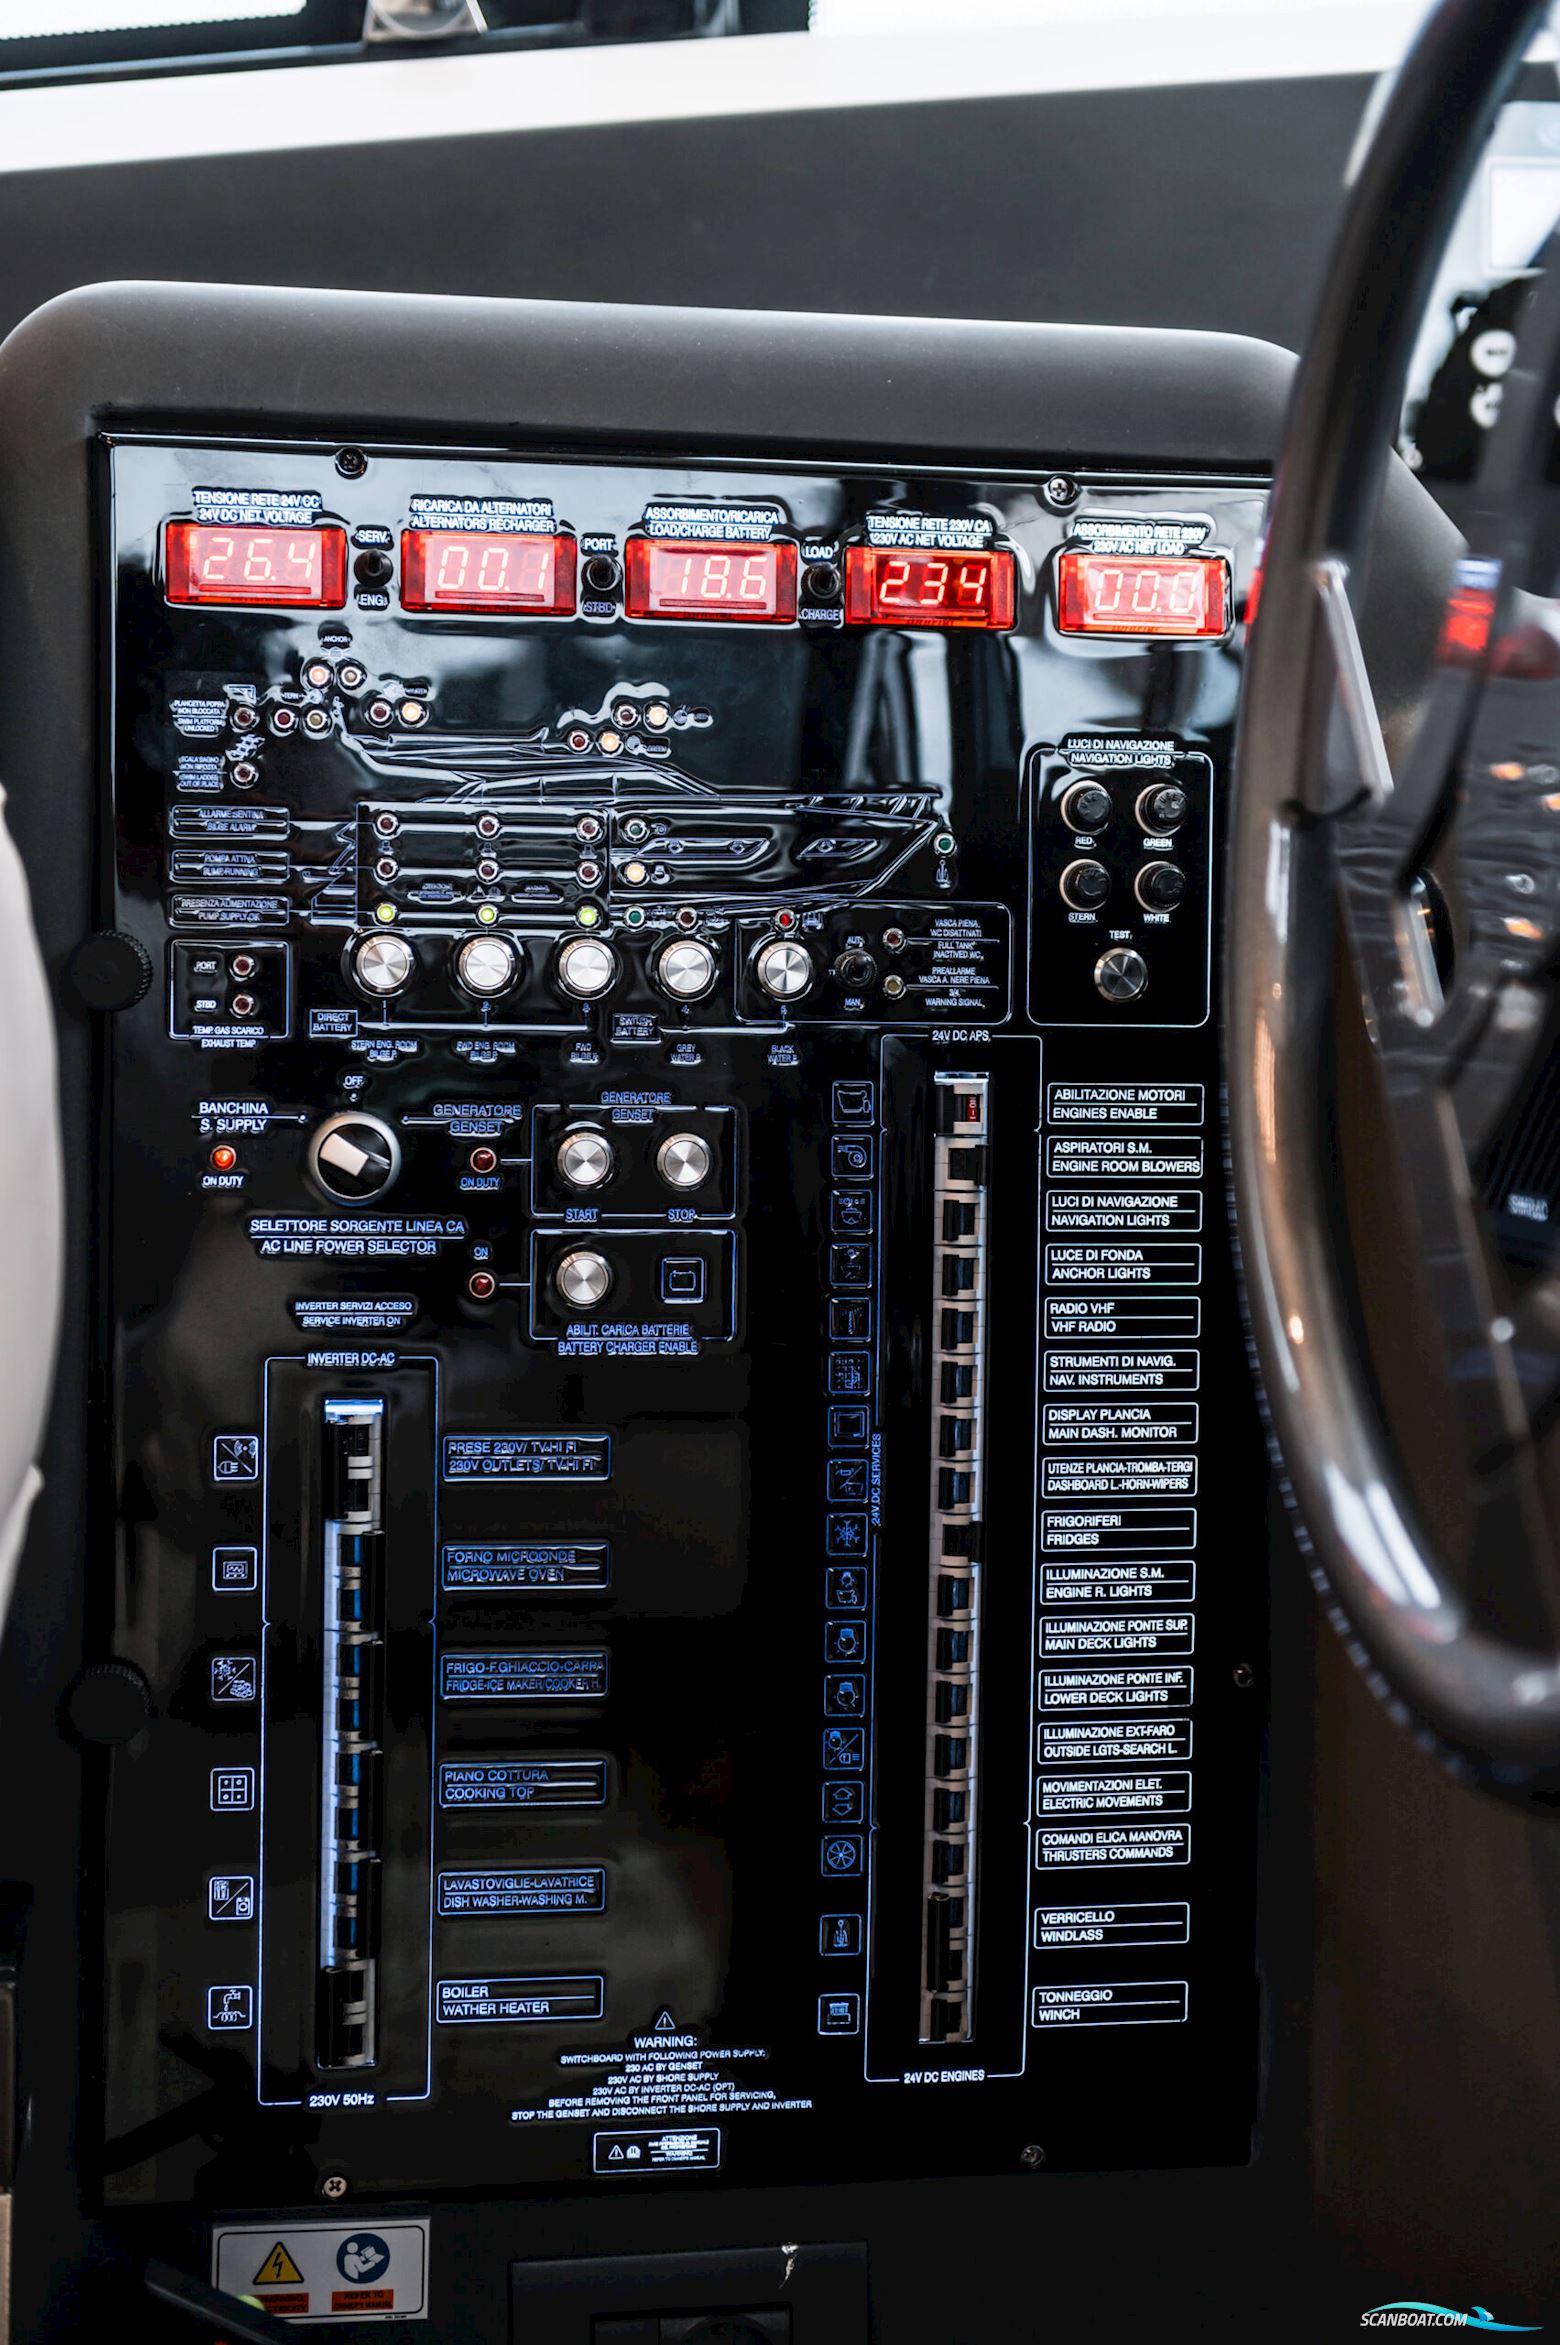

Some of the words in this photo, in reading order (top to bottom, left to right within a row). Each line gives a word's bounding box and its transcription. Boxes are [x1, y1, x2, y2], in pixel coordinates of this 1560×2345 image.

[194, 491, 249, 505] TENSIONE
[251, 493, 279, 506] RETE
[281, 495, 300, 507] 24V
[302, 495, 319, 508] CC
[413, 499, 462, 513] RICARICA
[465, 501, 479, 514] DA
[482, 502, 550, 516] ALTERNATORI
[200, 509, 220, 520] 24V
[221, 510, 238, 521] DC
[242, 511, 260, 522] NET
[264, 511, 312, 523] VOLTAGE
[646, 507, 778, 524] ASSORBIMENTO/RICARICA
[412, 516, 487, 529] ALTERNATORS
[489, 518, 553, 531] RECHARGER
[870, 516, 920, 530] TENSIONE
[922, 518, 948, 530] RETE
[950, 519, 973, 531] 230V
[975, 520, 990, 532] CA
[651, 525, 724, 537] LOAD/CHARGE
[725, 526, 771, 538] BATTERY
[585, 538, 613, 550] PORT
[873, 534, 897, 544] 230V
[900, 535, 913, 545] AC
[916, 535, 936, 546] NET
[938, 535, 983, 548] VOLTAGE
[805, 547, 833, 558] LOAD
[203, 538, 316, 581] 26.4
[438, 546, 549, 591] 00.1
[681, 555, 768, 599] 18.6
[880, 561, 986, 604] 234
[585, 603, 613, 613] STBD
[802, 609, 839, 620] CHARGE
[1068, 739, 1091, 749] LUCI
[1093, 740, 1104, 750] DI
[1106, 740, 1174, 751] NAVIGAZIONE
[1071, 753, 1132, 764] NAVIGATION
[1135, 754, 1172, 766] LIGHTS
[1075, 837, 1092, 845] RED
[1144, 839, 1172, 847] GREEN
[1069, 913, 1096, 921] STERN
[1144, 914, 1169, 922] WHITE
[1110, 931, 1130, 939] TEST
[345, 1076, 363, 1085] OFF
[1054, 1090, 1135, 1100] ABILITAZIONE
[1138, 1090, 1185, 1101] MOTORI
[199, 1102, 268, 1114] BANCHINA
[433, 1104, 521, 1116] GENERATORE
[1053, 1108, 1107, 1118] ENGINES
[1110, 1108, 1157, 1119] ENABLE
[201, 1119, 212, 1130] S.
[216, 1119, 266, 1130] SUPPLY
[451, 1121, 502, 1132] GENSET
[1054, 1142, 1124, 1153] ASPIRATORI
[1127, 1143, 1152, 1153] S.M.
[1053, 1161, 1098, 1171] ENGINE
[1102, 1161, 1138, 1172] ROOM
[1142, 1161, 1200, 1172] BLOWERS
[202, 1176, 217, 1186] ON
[219, 1176, 243, 1186] DUTY
[566, 1209, 598, 1219] START
[668, 1209, 695, 1219] STOP
[251, 1220, 327, 1231] SELETTORE
[330, 1221, 402, 1232] SORGENTE
[406, 1221, 442, 1231] LINEA
[446, 1221, 464, 1231] CA
[262, 1241, 280, 1251] AC
[284, 1241, 312, 1251] LINE
[316, 1241, 364, 1252] POWER
[367, 1241, 436, 1252] SELECTOR
[1051, 1250, 1083, 1260] LUCE
[1086, 1250, 1098, 1260] DI
[1101, 1250, 1143, 1260] FONDA
[1052, 1268, 1105, 1279] ANCHOR
[1108, 1268, 1151, 1279] LIGHTS
[1050, 1303, 1088, 1314] RADIO
[1090, 1303, 1115, 1313] VHF
[566, 1324, 598, 1336] ABILIT.
[601, 1324, 639, 1336] CARICA
[642, 1324, 689, 1336] BATTERIE
[1052, 1321, 1076, 1332] VHF
[1079, 1321, 1116, 1332] RADIO
[559, 1341, 602, 1353] BATTERY
[607, 1342, 656, 1353] CHARGER
[659, 1342, 697, 1353] ENABLE
[308, 1353, 359, 1364] INVERTER
[361, 1353, 395, 1364] DC-AC
[1050, 1356, 1118, 1367] STRUMENTI
[1122, 1356, 1134, 1366] DI
[1137, 1355, 1176, 1366] NAVIG.
[1050, 1374, 1075, 1385] NAV.
[1079, 1374, 1163, 1385] INSTRUMENTS
[1049, 1410, 1098, 1421] DISPLAY
[1100, 1409, 1151, 1420] PLANCIA
[1049, 1428, 1079, 1439] MAIN
[1082, 1428, 1118, 1438] DASH.
[1122, 1427, 1177, 1438] MONITOR
[1048, 1463, 1084, 1474] UTENZE
[1086, 1461, 1193, 1473] PLANCIA-TROMBA-TERGI
[1048, 1479, 1108, 1491] DASHBOARD
[1111, 1478, 1189, 1489] L.-HORN-WIPERS
[1047, 1515, 1121, 1527] FRIGORIFERI
[1047, 1534, 1099, 1545] FRIDGES
[1046, 1568, 1137, 1580] ILLUMINAZIONE
[1140, 1567, 1164, 1578] S.M.
[1046, 1587, 1092, 1599] ENGINE
[1095, 1586, 1106, 1597] R.
[1110, 1585, 1152, 1597] LIGHTS
[1045, 1621, 1125, 1633] ILLUMINAZIONE
[1128, 1620, 1163, 1631] PONTE
[1166, 1619, 1188, 1630] SUP.
[1045, 1639, 1075, 1650] MAIN
[1078, 1638, 1112, 1649] DECK
[1114, 1637, 1157, 1648] LIGHTS
[1043, 1780, 1133, 1793] MOVIMENTAZIONI
[1135, 1779, 1162, 1790] ELET.
[1043, 1798, 1094, 1810] ELECTRIC
[1096, 1795, 1163, 1808] MOVEMENTS
[1042, 1833, 1093, 1845] COMANDI
[1096, 1831, 1127, 1843] ELICA
[1129, 1830, 1182, 1842] MANOVRA
[1043, 1849, 1107, 1862] THRUSTERS
[1109, 1847, 1173, 1859] COMMANDS
[443, 1876, 594, 1890] LAVASTOVIGLIE-LAVATRICE
[444, 1897, 469, 1908] DISH
[472, 1894, 572, 1907] WASHER-WASHING
[575, 1895, 587, 1904] M.
[1042, 1911, 1115, 1924] VERRICELLO
[1041, 1929, 1103, 1942] WINDLASS
[442, 1986, 489, 1998] BOILER
[1039, 1990, 1113, 2003] TONNEGGIO
[443, 2003, 496, 2016] WATHER
[500, 2002, 549, 2014] HEATER
[1039, 2009, 1080, 2021] WINCH
[634, 2036, 697, 2048] WARNING:
[561, 2054, 623, 2064] SWITCHBOARD
[648, 2051, 698, 2061] FOLLOWING
[904, 2073, 922, 2083] 24V
[924, 2072, 939, 2082] DC
[941, 2070, 985, 2082] ENGINES
[310, 2095, 340, 2107] 230V
[343, 2094, 374, 2105] 50Hz
